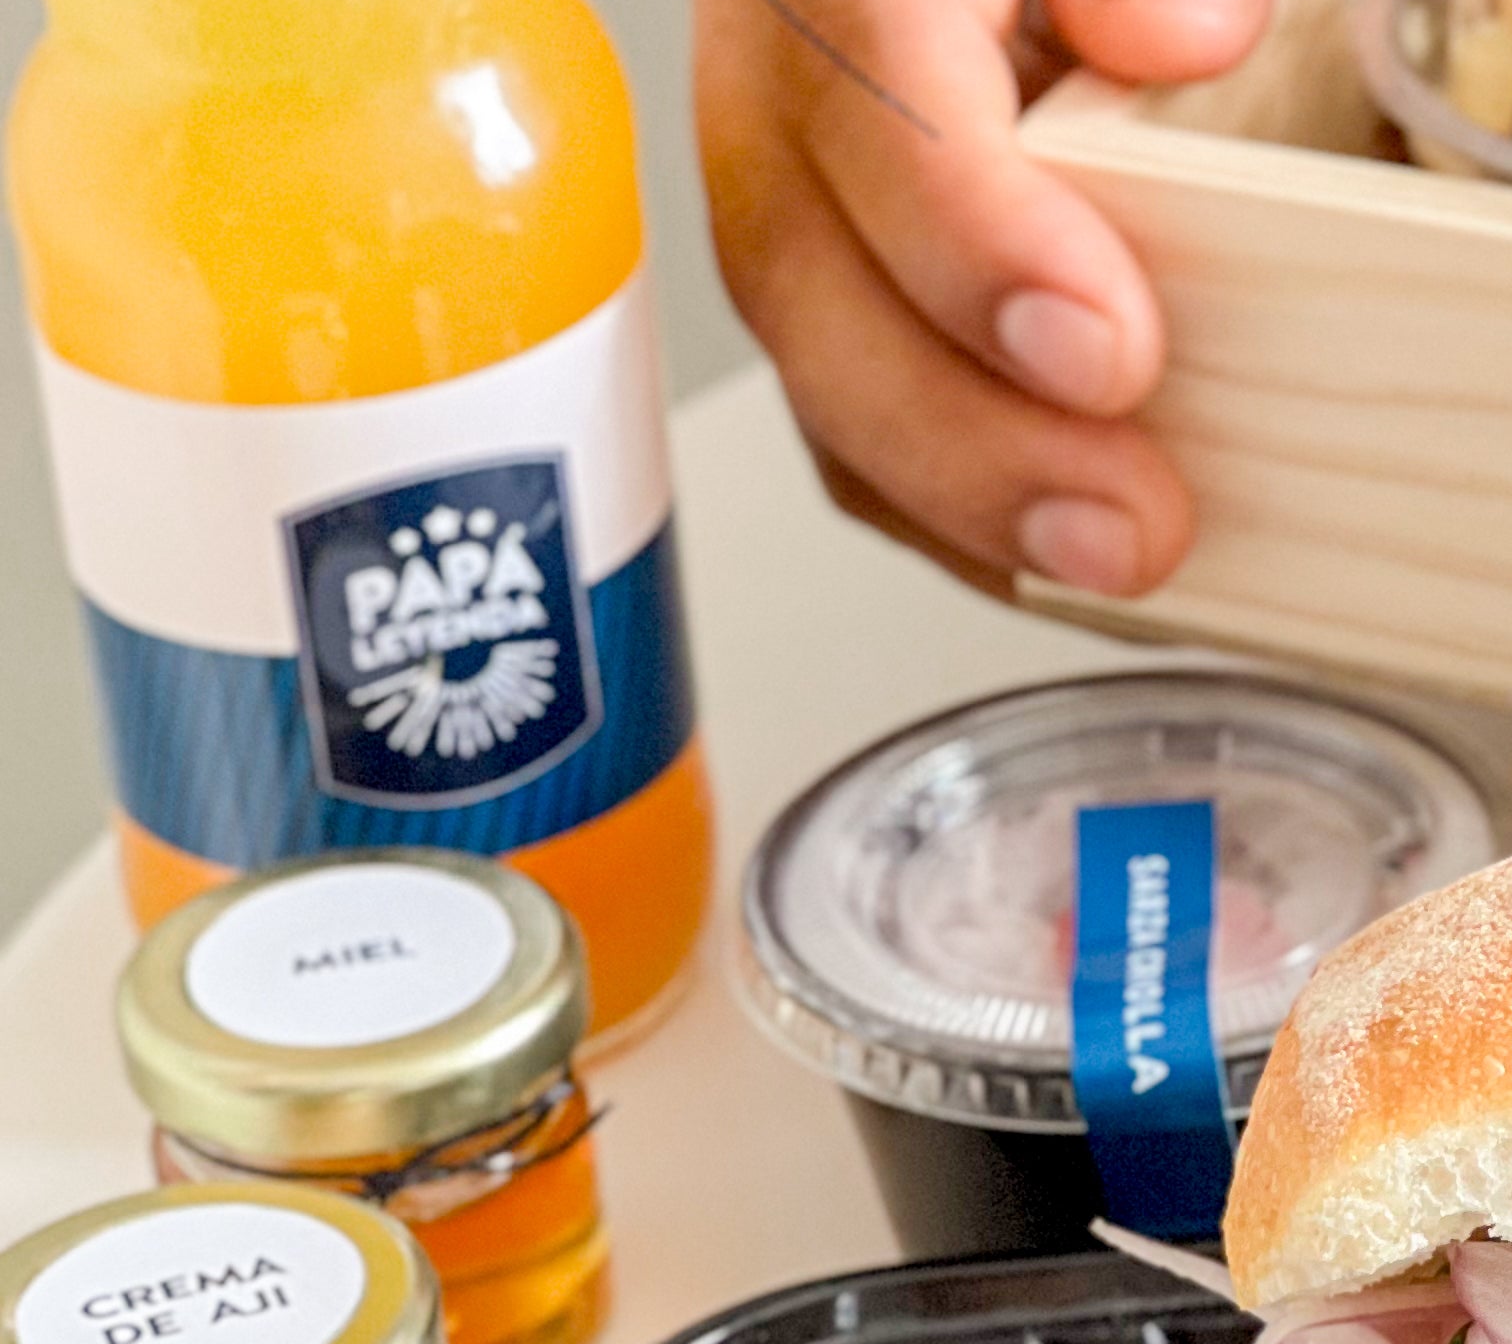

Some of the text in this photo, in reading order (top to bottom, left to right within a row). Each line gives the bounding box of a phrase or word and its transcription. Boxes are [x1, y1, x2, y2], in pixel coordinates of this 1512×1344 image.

[345, 522, 544, 635] PAPÁ
[292, 937, 417, 978] MIEL
[82, 1256, 289, 1320] CREMA
[210, 1286, 291, 1327] AJI
